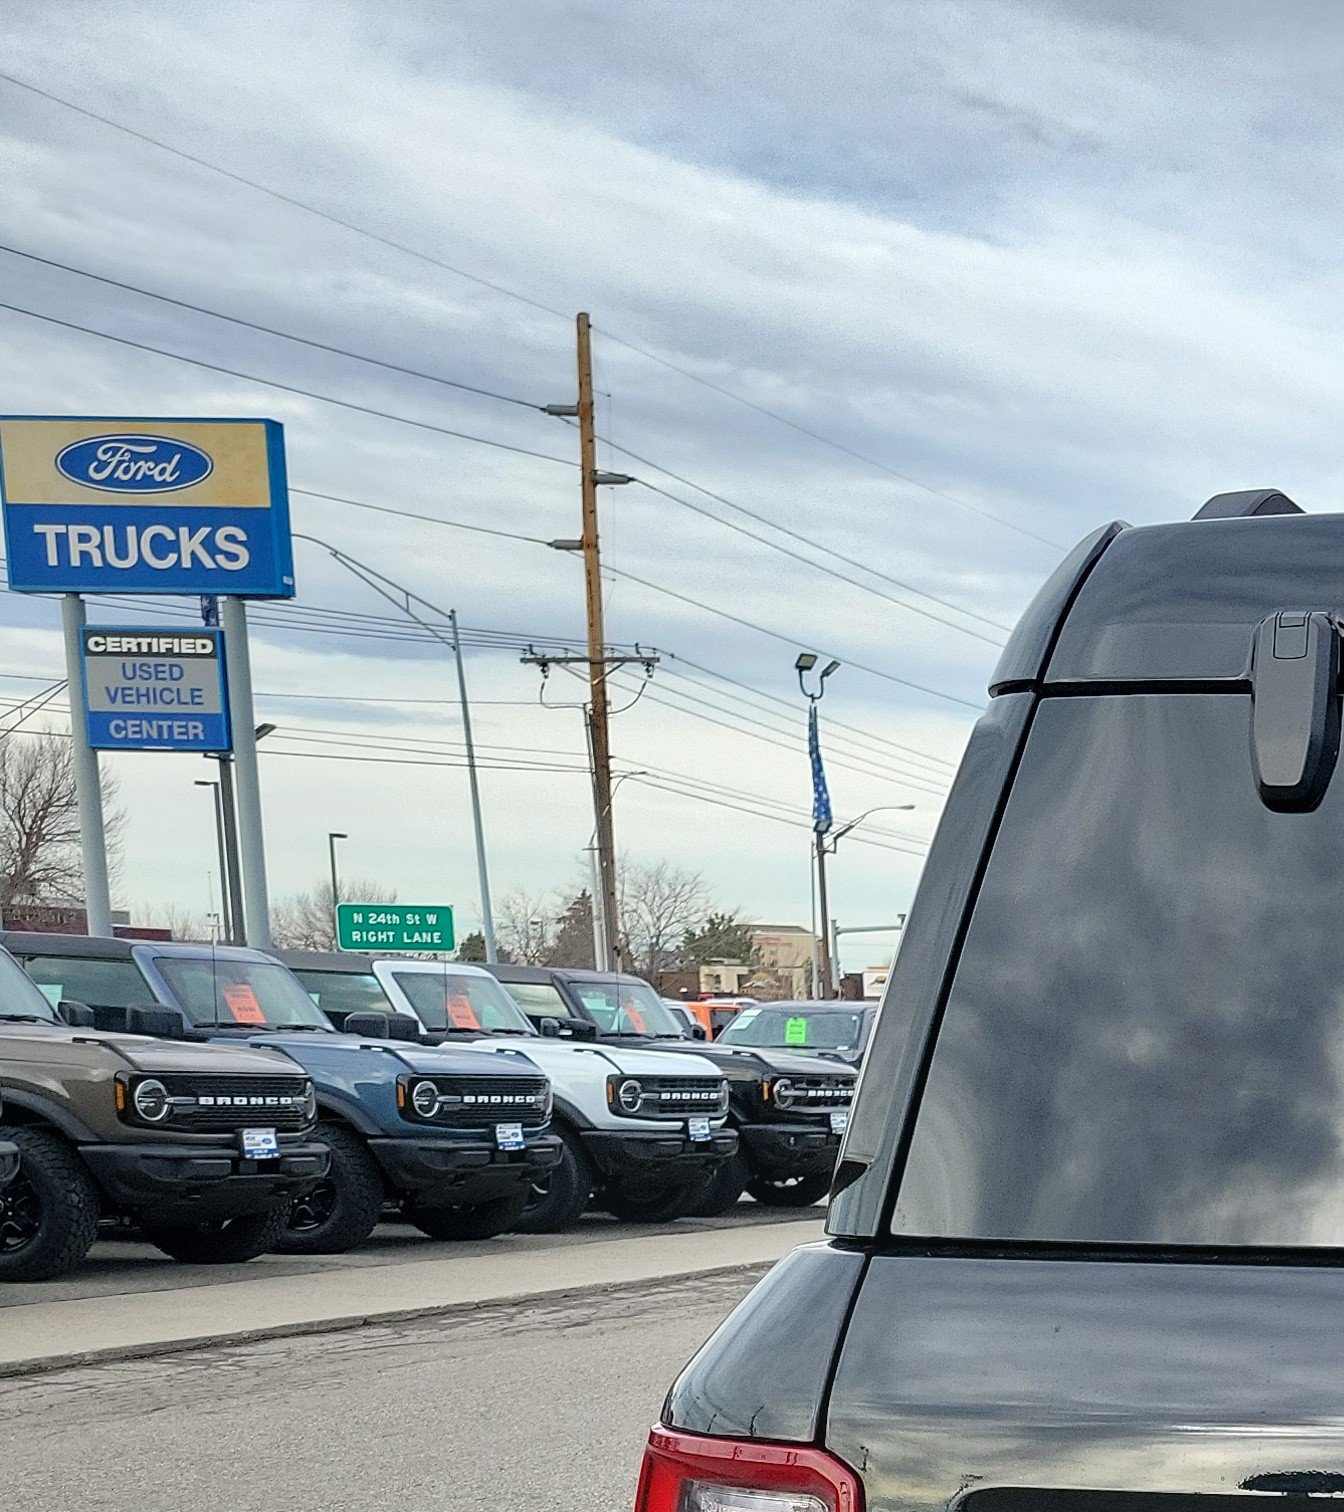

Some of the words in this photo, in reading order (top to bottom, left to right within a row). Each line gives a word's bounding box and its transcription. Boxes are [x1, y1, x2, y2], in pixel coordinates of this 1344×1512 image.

[88, 442, 182, 483] Ford
[33, 524, 251, 571] TRUCKS
[87, 636, 214, 655] CERTIFIED
[121, 662, 184, 682] USED
[105, 686, 204, 706] VEHICLE
[108, 719, 205, 740] CENTER
[352, 912, 363, 924] N
[368, 912, 400, 925] 24th
[405, 913, 421, 925] St
[426, 913, 437, 925] W
[351, 931, 395, 943] RIGHT
[403, 931, 442, 943] LANE
[198, 1096, 293, 1105] BRONCO
[463, 1095, 535, 1103] BRONCO
